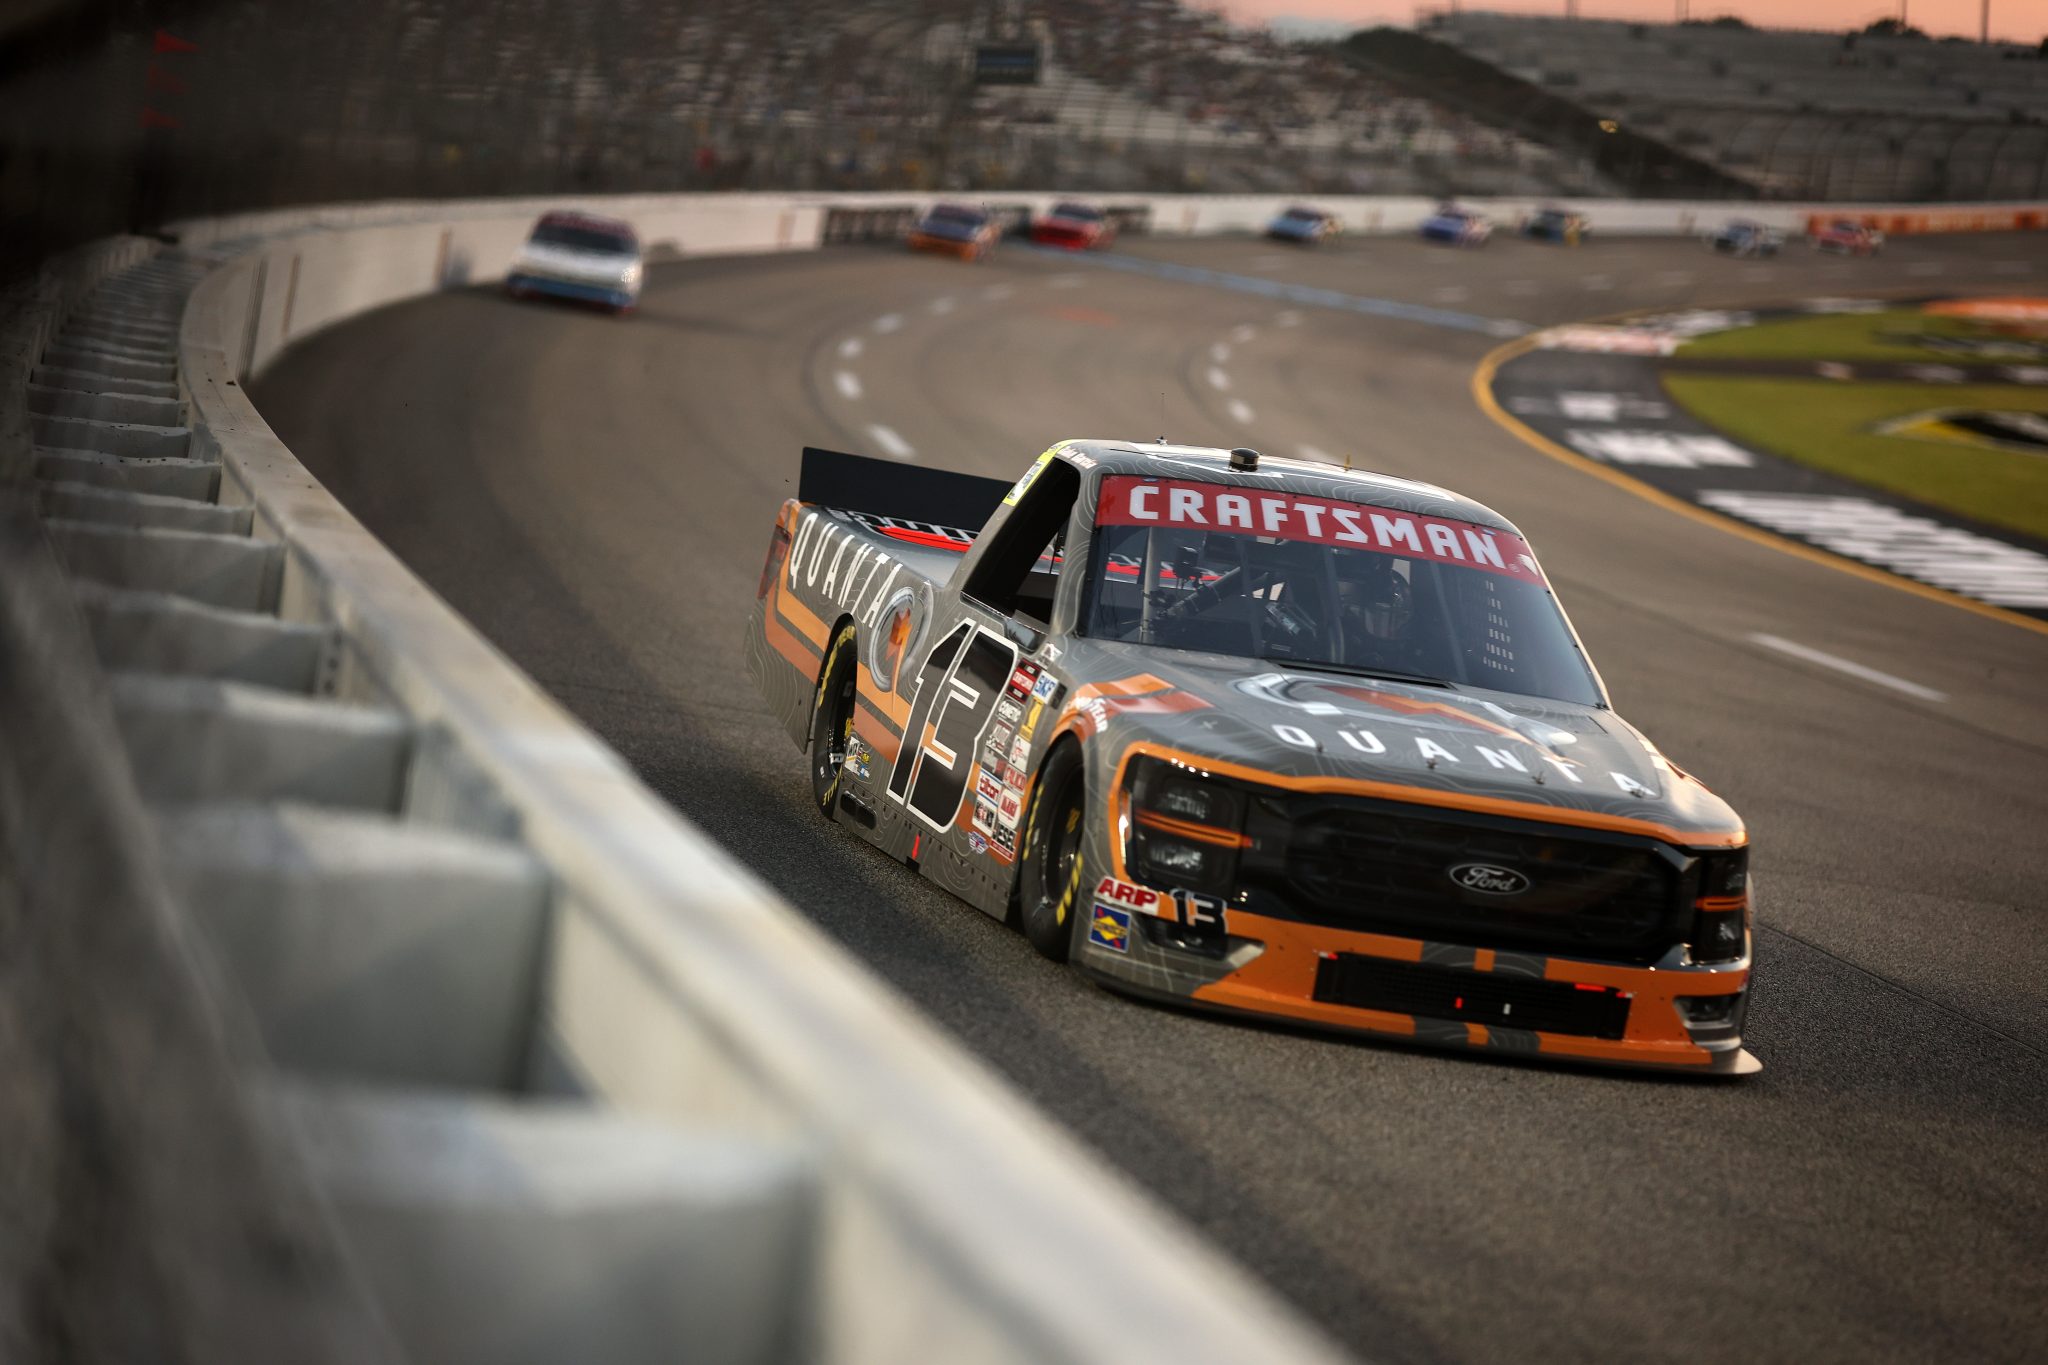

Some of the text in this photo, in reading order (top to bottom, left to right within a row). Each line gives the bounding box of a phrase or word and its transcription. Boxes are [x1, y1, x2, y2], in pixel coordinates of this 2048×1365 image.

[1128, 485, 1507, 570] CRAFTSMAN
[789, 512, 904, 629] QUANTA
[1033, 674, 1057, 698] SKF
[886, 616, 1019, 834] 13
[1271, 723, 1657, 797] QUANTA
[1097, 877, 1158, 908] ARP
[1463, 866, 1517, 891] Ford
[1167, 887, 1229, 936] 13
